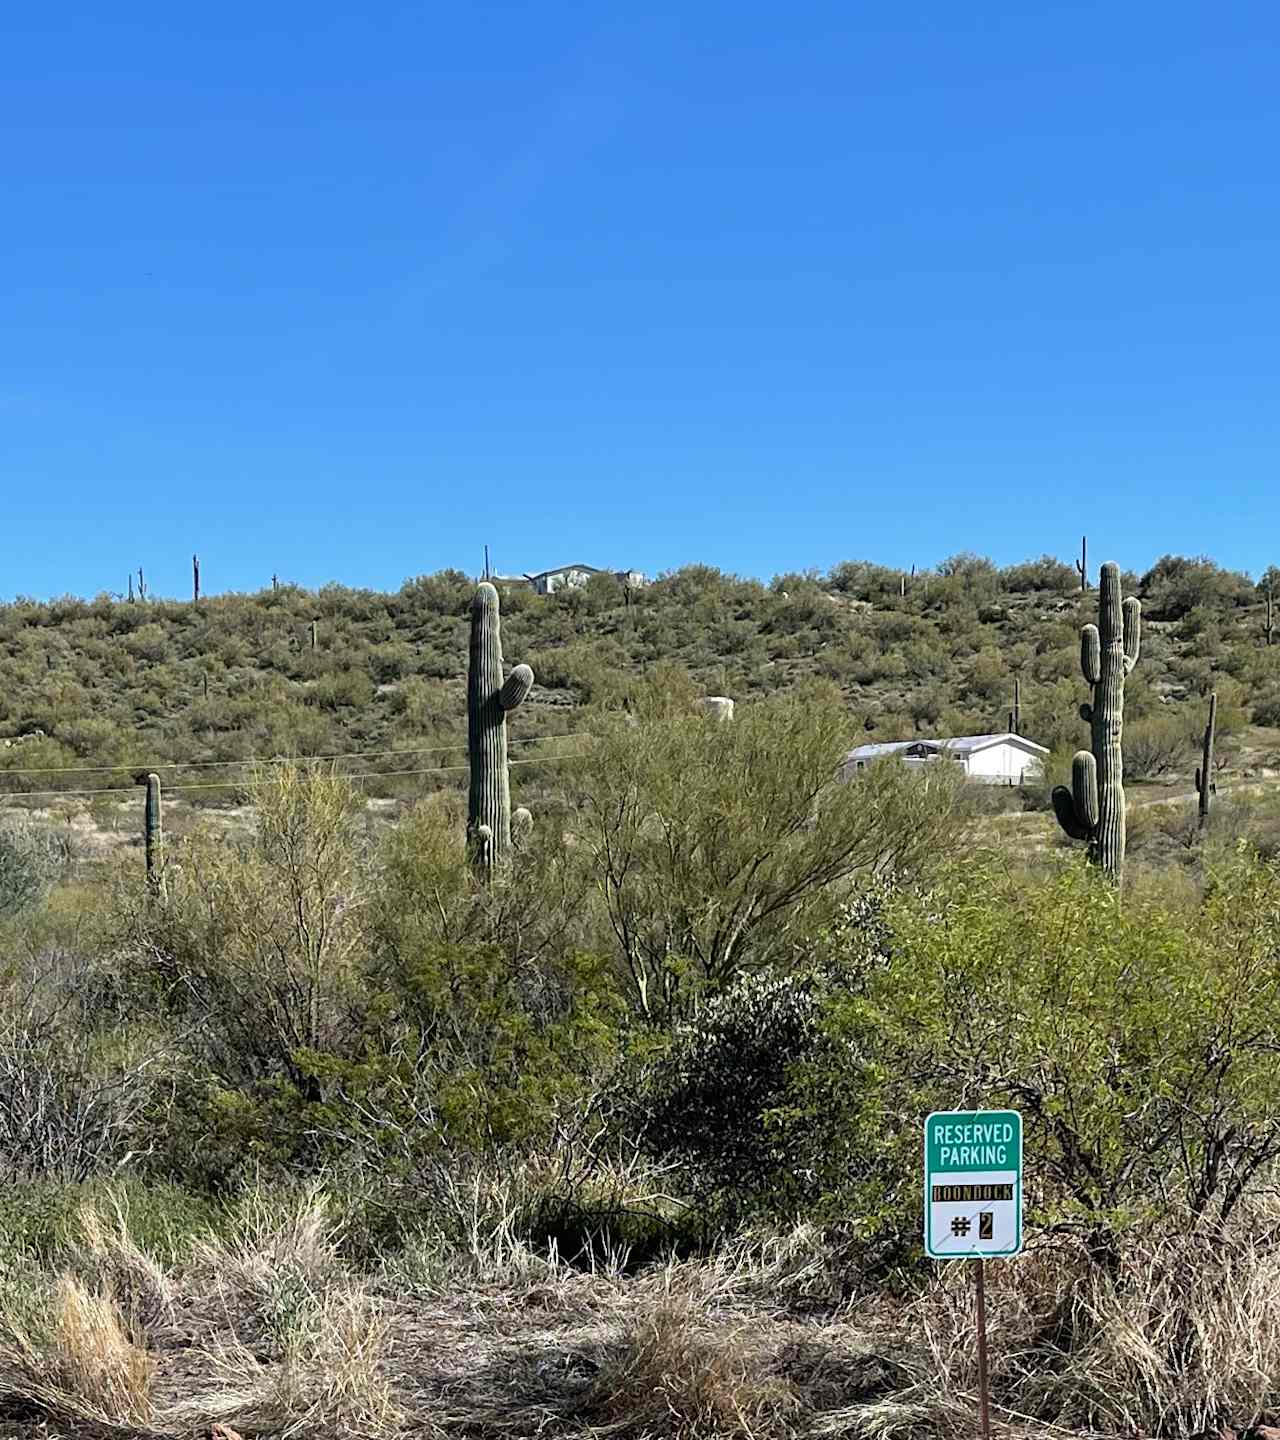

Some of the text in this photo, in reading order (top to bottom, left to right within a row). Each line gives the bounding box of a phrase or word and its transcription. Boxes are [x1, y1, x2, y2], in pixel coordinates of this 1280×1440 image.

[934, 1124, 1013, 1145] RESERVED
[940, 1145, 1007, 1166] PARKING
[933, 1185, 1012, 1201] BOONDOCK
